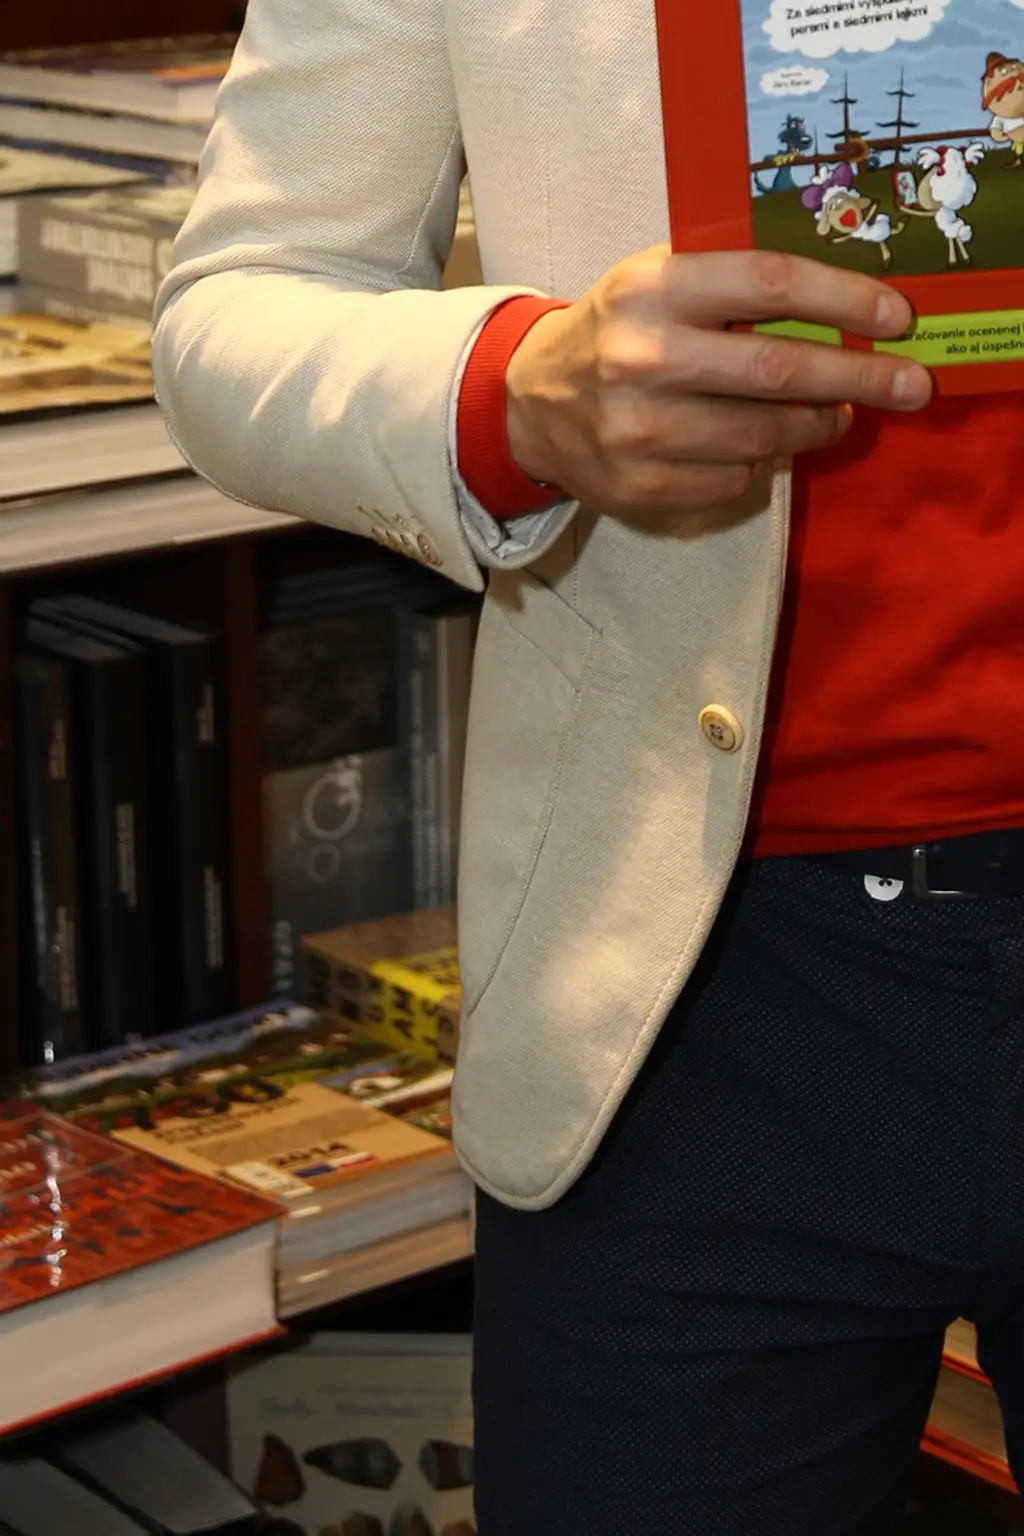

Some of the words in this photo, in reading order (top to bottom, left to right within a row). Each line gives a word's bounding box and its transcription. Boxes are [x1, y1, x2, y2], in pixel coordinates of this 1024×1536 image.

[786, 8, 802, 20] Za
[907, 327, 966, 341] račovanie
[968, 323, 1021, 338] ocenenej
[945, 342, 968, 354] ako
[969, 342, 980, 354] aj
